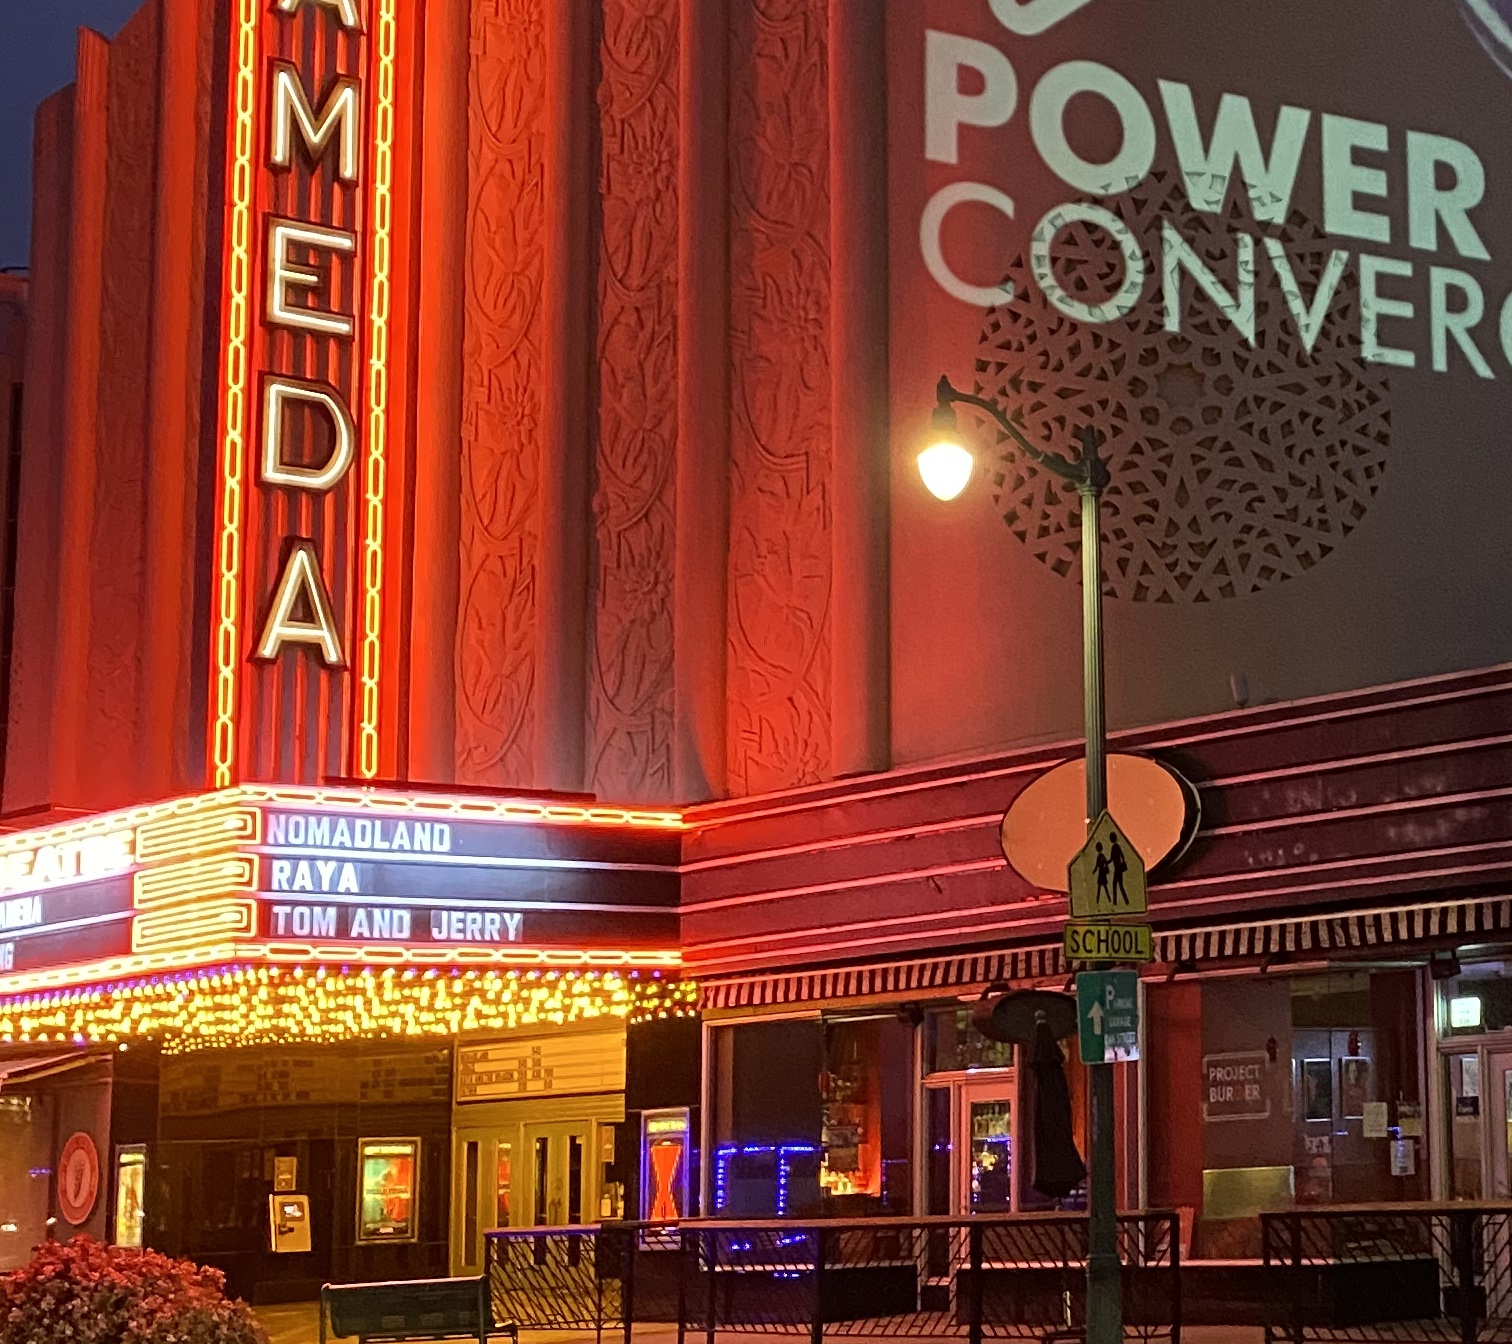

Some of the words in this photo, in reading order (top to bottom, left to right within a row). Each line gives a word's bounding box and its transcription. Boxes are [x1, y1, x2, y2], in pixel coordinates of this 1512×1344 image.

[926, 29, 1492, 261] POWER
[267, 814, 451, 852] NOMADLAND
[272, 859, 359, 893] RAYA
[273, 905, 337, 937] TOM
[350, 907, 411, 939] AND
[431, 911, 523, 942] JERRY
[1070, 929, 1144, 954] SCHOOL
[1209, 1064, 1260, 1082] PROJECT
